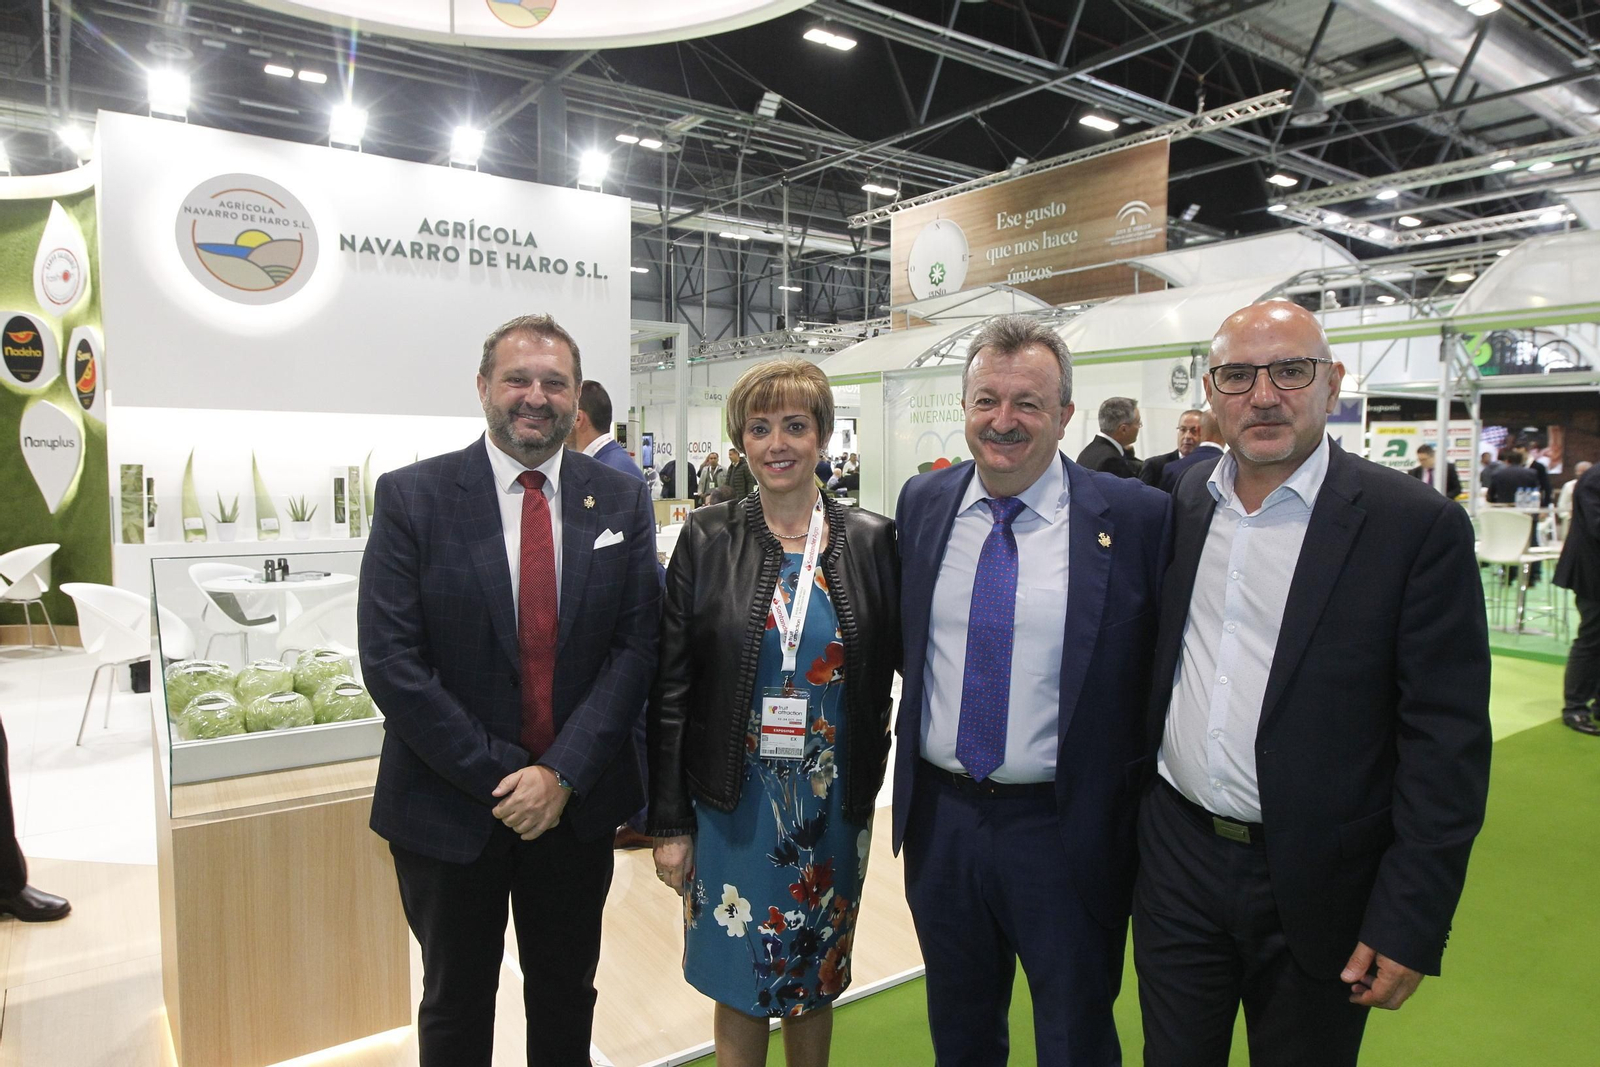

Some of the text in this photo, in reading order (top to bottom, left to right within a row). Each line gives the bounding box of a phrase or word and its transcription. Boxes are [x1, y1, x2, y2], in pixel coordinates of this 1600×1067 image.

[183, 206, 310, 229] NAVARRO DE HARO S.L.
[218, 200, 275, 215] AGRÍCOLA
[997, 201, 1067, 231] Ese gusto
[418, 217, 538, 248] AGRÍCOLA
[339, 233, 608, 280] NAVARRO DE HARO S.L.
[986, 230, 1079, 266] que nos hace
[1007, 265, 1053, 285] únicos
[910, 392, 962, 408] CULTIVOS
